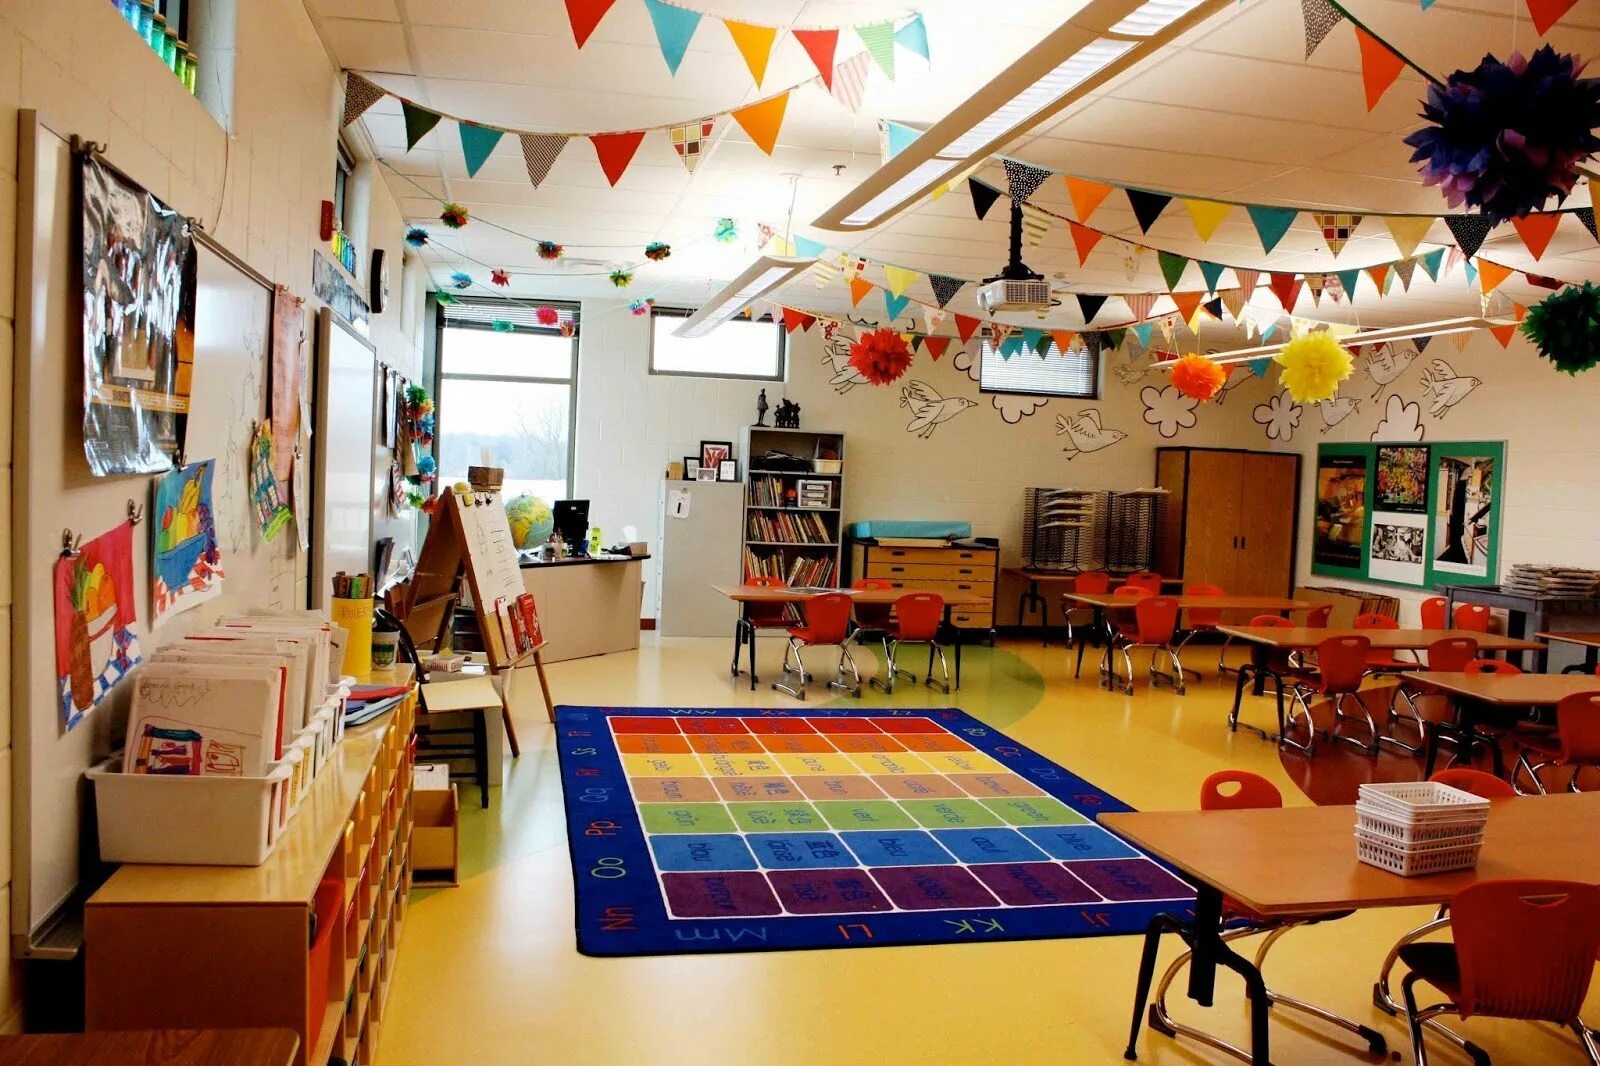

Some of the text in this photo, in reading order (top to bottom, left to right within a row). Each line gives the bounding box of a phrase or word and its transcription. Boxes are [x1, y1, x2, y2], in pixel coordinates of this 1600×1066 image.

[933, 803, 966, 824] verde
[1007, 801, 1048, 822] green
[585, 820, 622, 836] Pp
[688, 841, 713, 862] blau
[877, 837, 909, 857] bleu
[971, 837, 1007, 854] azul
[1057, 832, 1092, 851] blue
[590, 857, 627, 879] Oo
[597, 904, 637, 931] Nn
[675, 927, 767, 941] Mm
